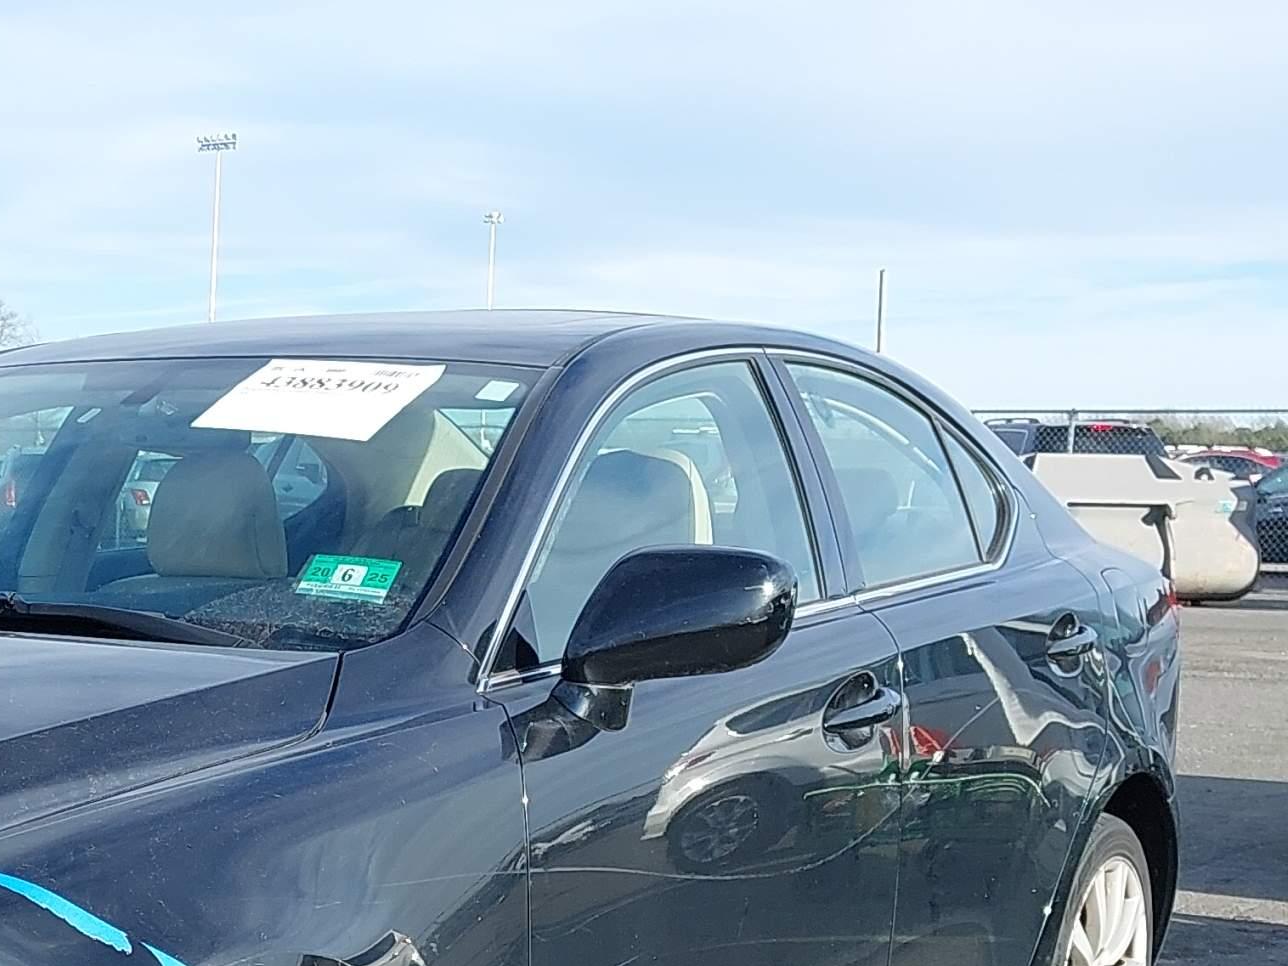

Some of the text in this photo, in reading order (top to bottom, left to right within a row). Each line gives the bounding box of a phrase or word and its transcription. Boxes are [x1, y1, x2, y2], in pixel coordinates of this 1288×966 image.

[261, 376, 400, 393] 43883909
[312, 566, 390, 583] 20 6 25
